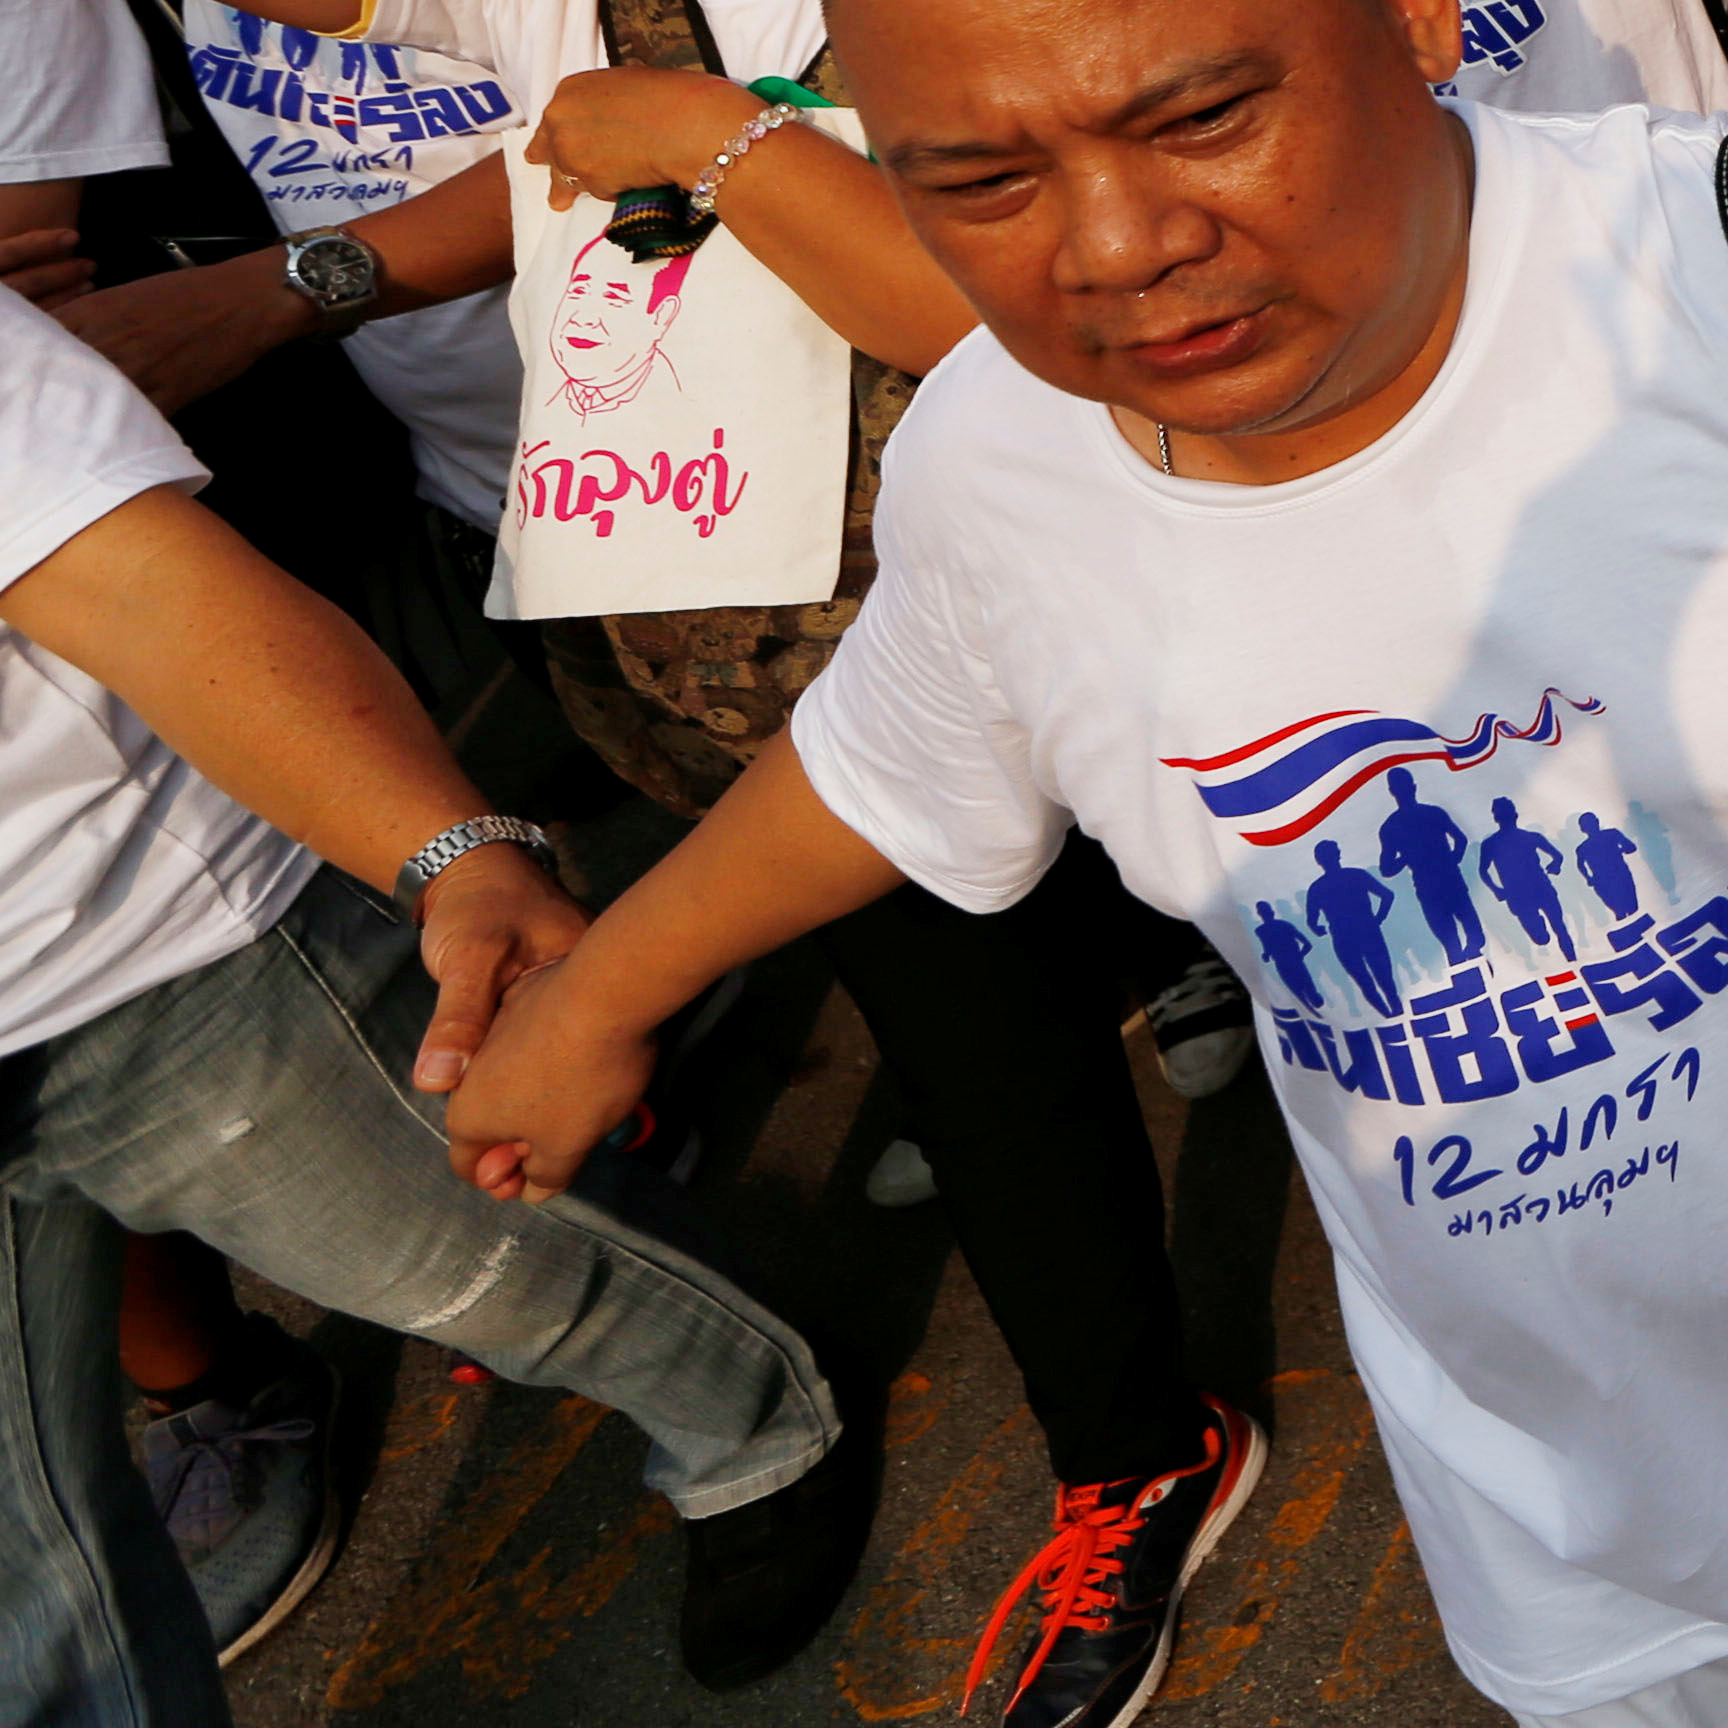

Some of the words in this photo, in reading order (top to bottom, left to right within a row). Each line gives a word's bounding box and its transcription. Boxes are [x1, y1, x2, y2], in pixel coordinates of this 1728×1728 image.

[248, 135, 330, 178] 12
[516, 428, 749, 539] รักลุงตู่
[1391, 1132, 1504, 1207] 12
[1517, 1046, 1702, 1161] มกรา
